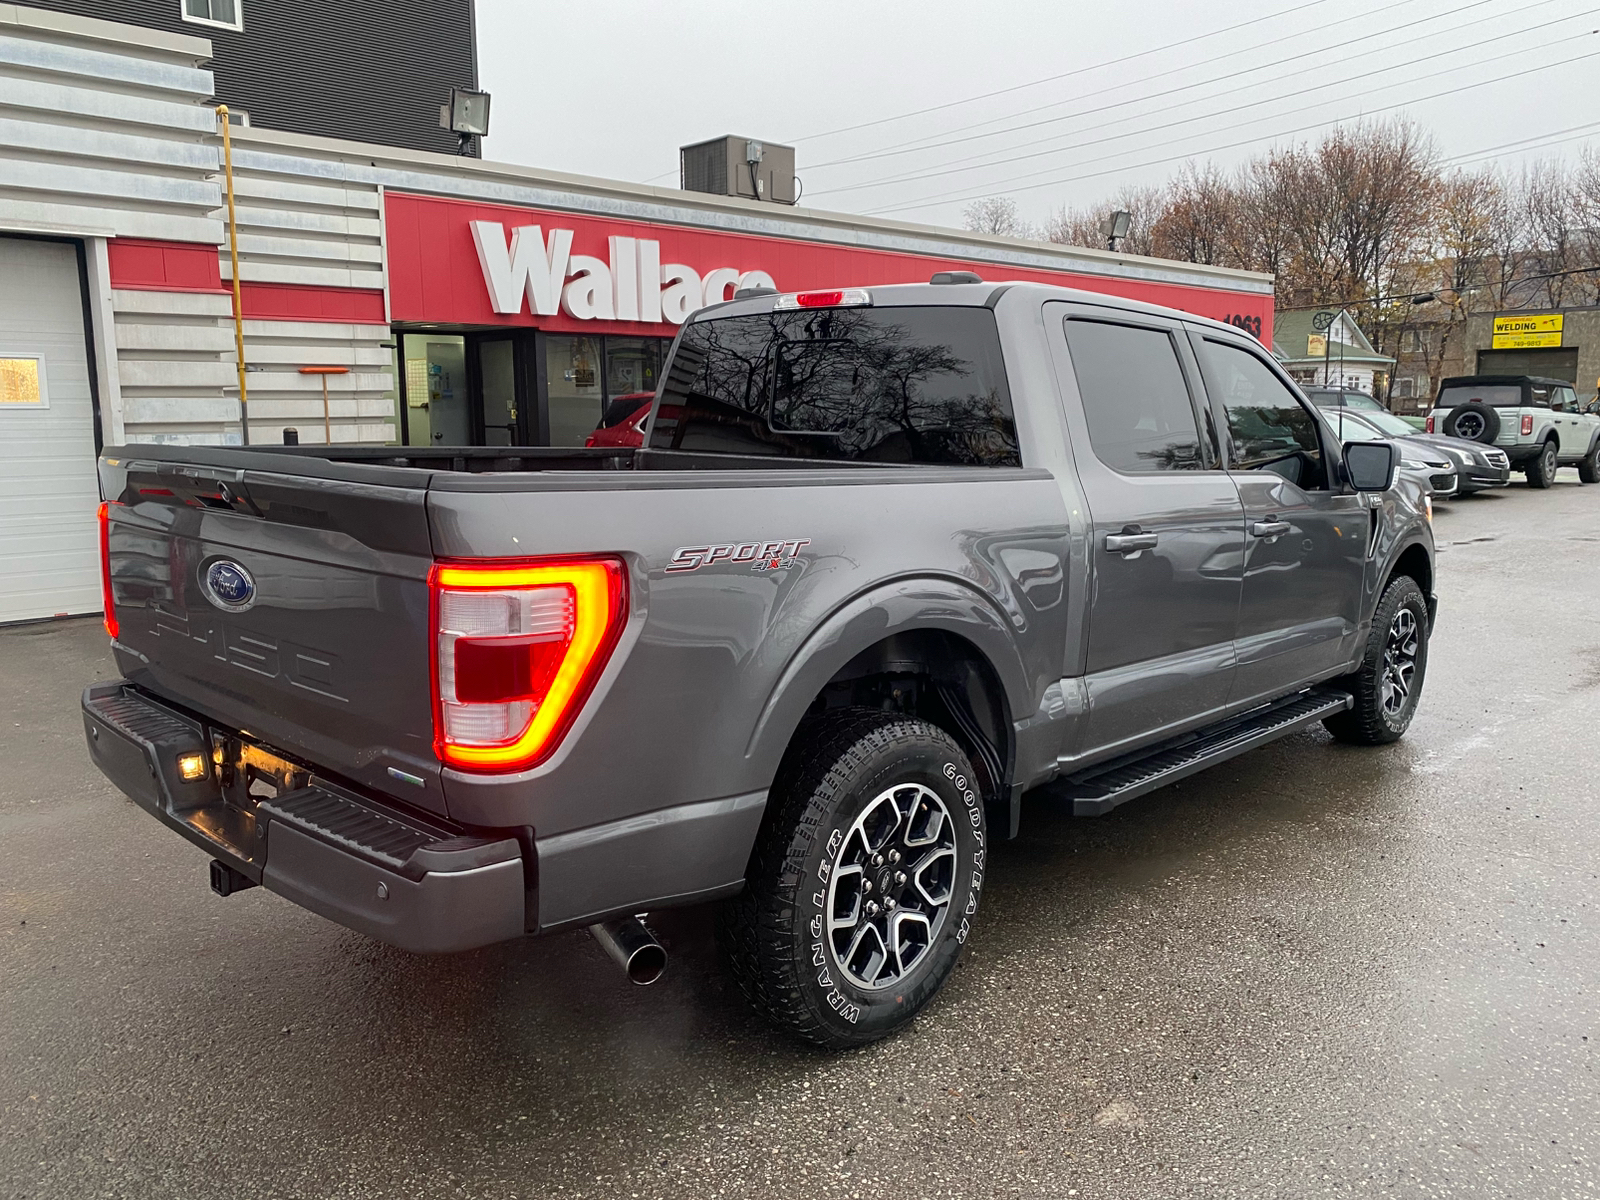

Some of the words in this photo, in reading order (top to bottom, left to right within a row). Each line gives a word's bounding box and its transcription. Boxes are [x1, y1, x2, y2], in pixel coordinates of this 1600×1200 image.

[1496, 323, 1536, 331] WELDING
[664, 538, 812, 573] SPORT
[942, 762, 985, 945] GOODYEAR
[810, 828, 860, 1025] WRANGLER
